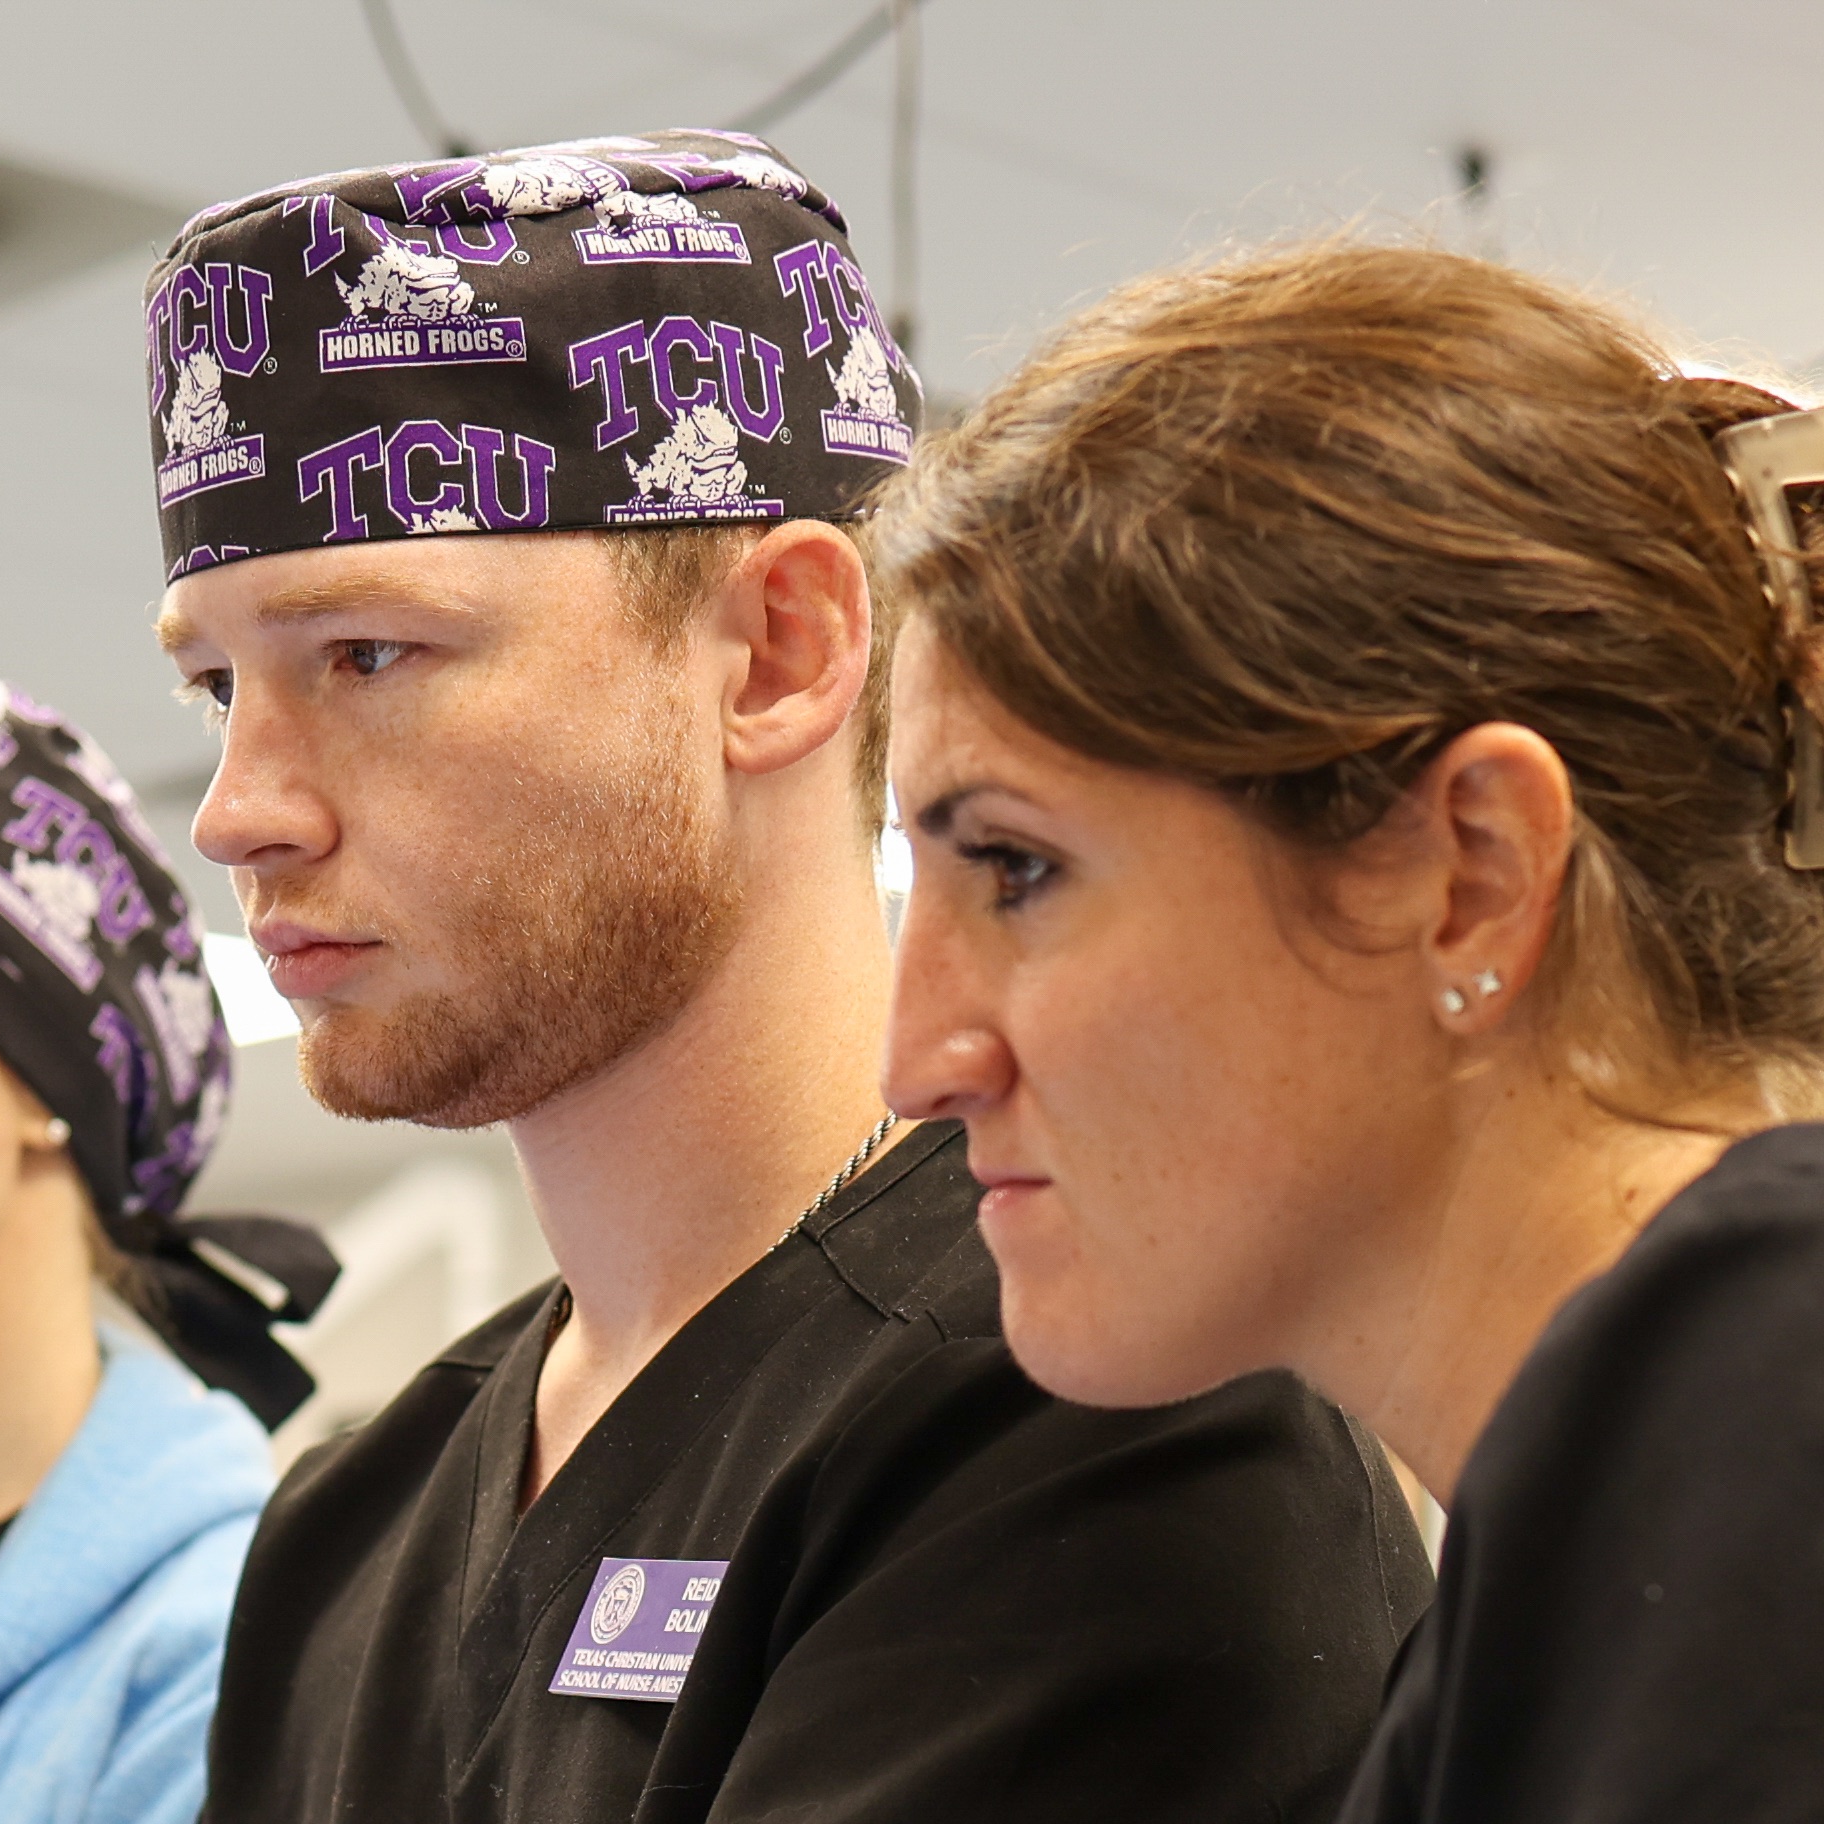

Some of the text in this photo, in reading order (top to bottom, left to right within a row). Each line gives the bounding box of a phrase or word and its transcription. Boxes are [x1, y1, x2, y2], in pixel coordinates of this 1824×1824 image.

[585, 227, 737, 256] HORNED FROGS
[146, 262, 274, 417] TCU
[326, 327, 505, 362] HORNED FROGS
[568, 315, 785, 453] TCU
[827, 417, 880, 448] HORNED
[160, 445, 249, 498] HORNED FROGS
[296, 419, 557, 542] TCU
[0, 775, 156, 944] TCU
[681, 1577, 722, 1602] REID
[572, 1648, 607, 1666] TEXAS
[605, 1650, 661, 1670] CHRISTIAN
[557, 1669, 602, 1688] SCHOOL
[601, 1672, 619, 1690] OF
[617, 1673, 654, 1692] NURSE
